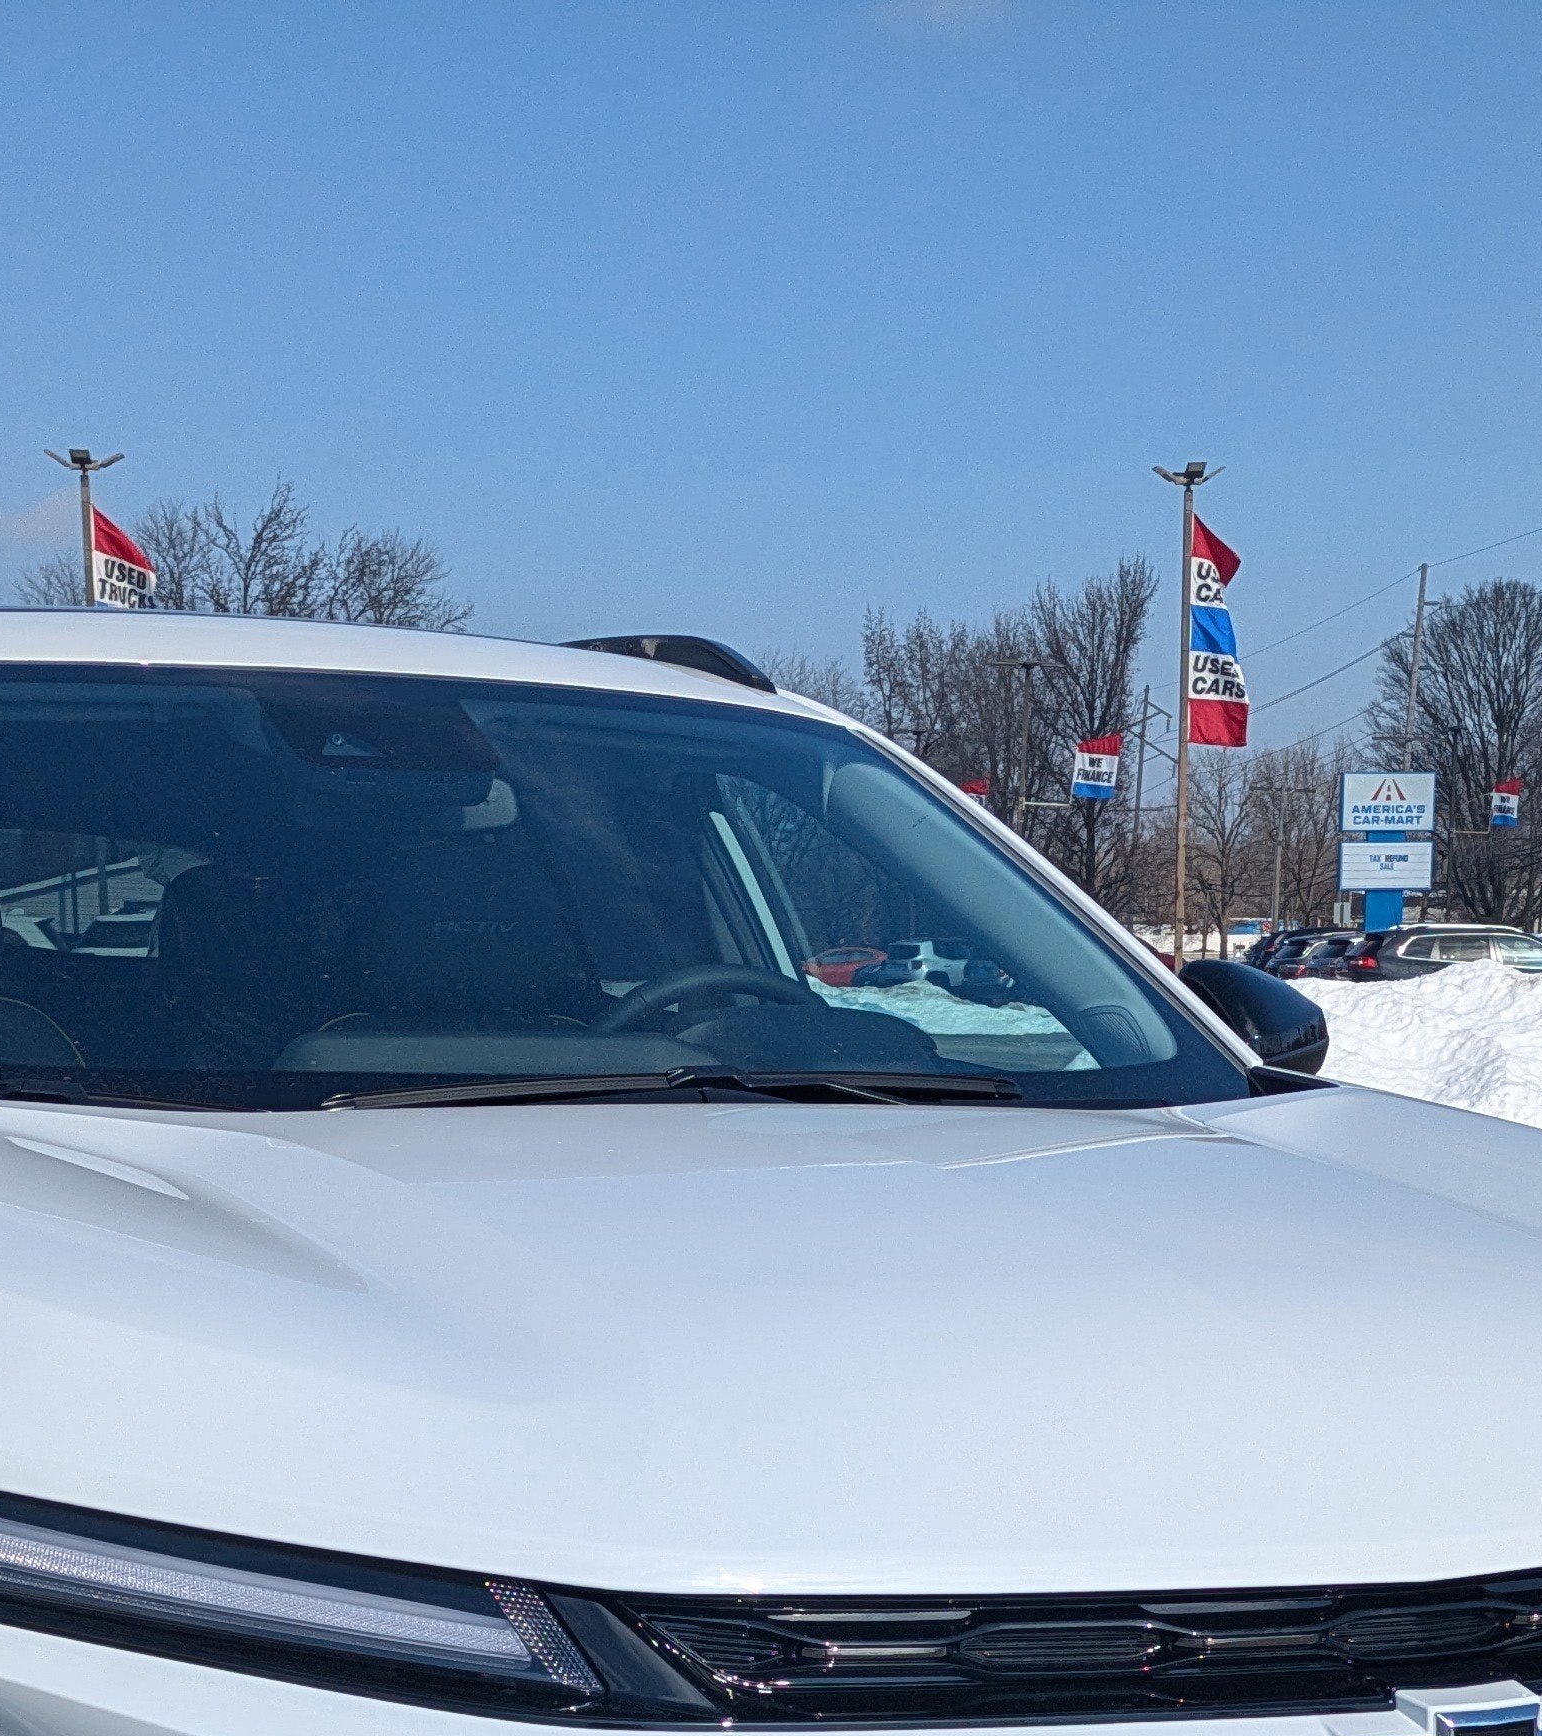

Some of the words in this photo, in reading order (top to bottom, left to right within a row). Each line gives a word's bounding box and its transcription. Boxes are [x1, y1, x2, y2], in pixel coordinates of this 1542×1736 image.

[104, 558, 147, 591] USED
[1192, 676, 1246, 699] CARS
[1088, 756, 1103, 768] WE
[1076, 767, 1114, 784] FINANCE
[1351, 804, 1426, 814] AMERICA'S
[1352, 815, 1423, 825] CAR-MART
[1369, 854, 1381, 863] TAX
[1379, 862, 1394, 871] SALE
